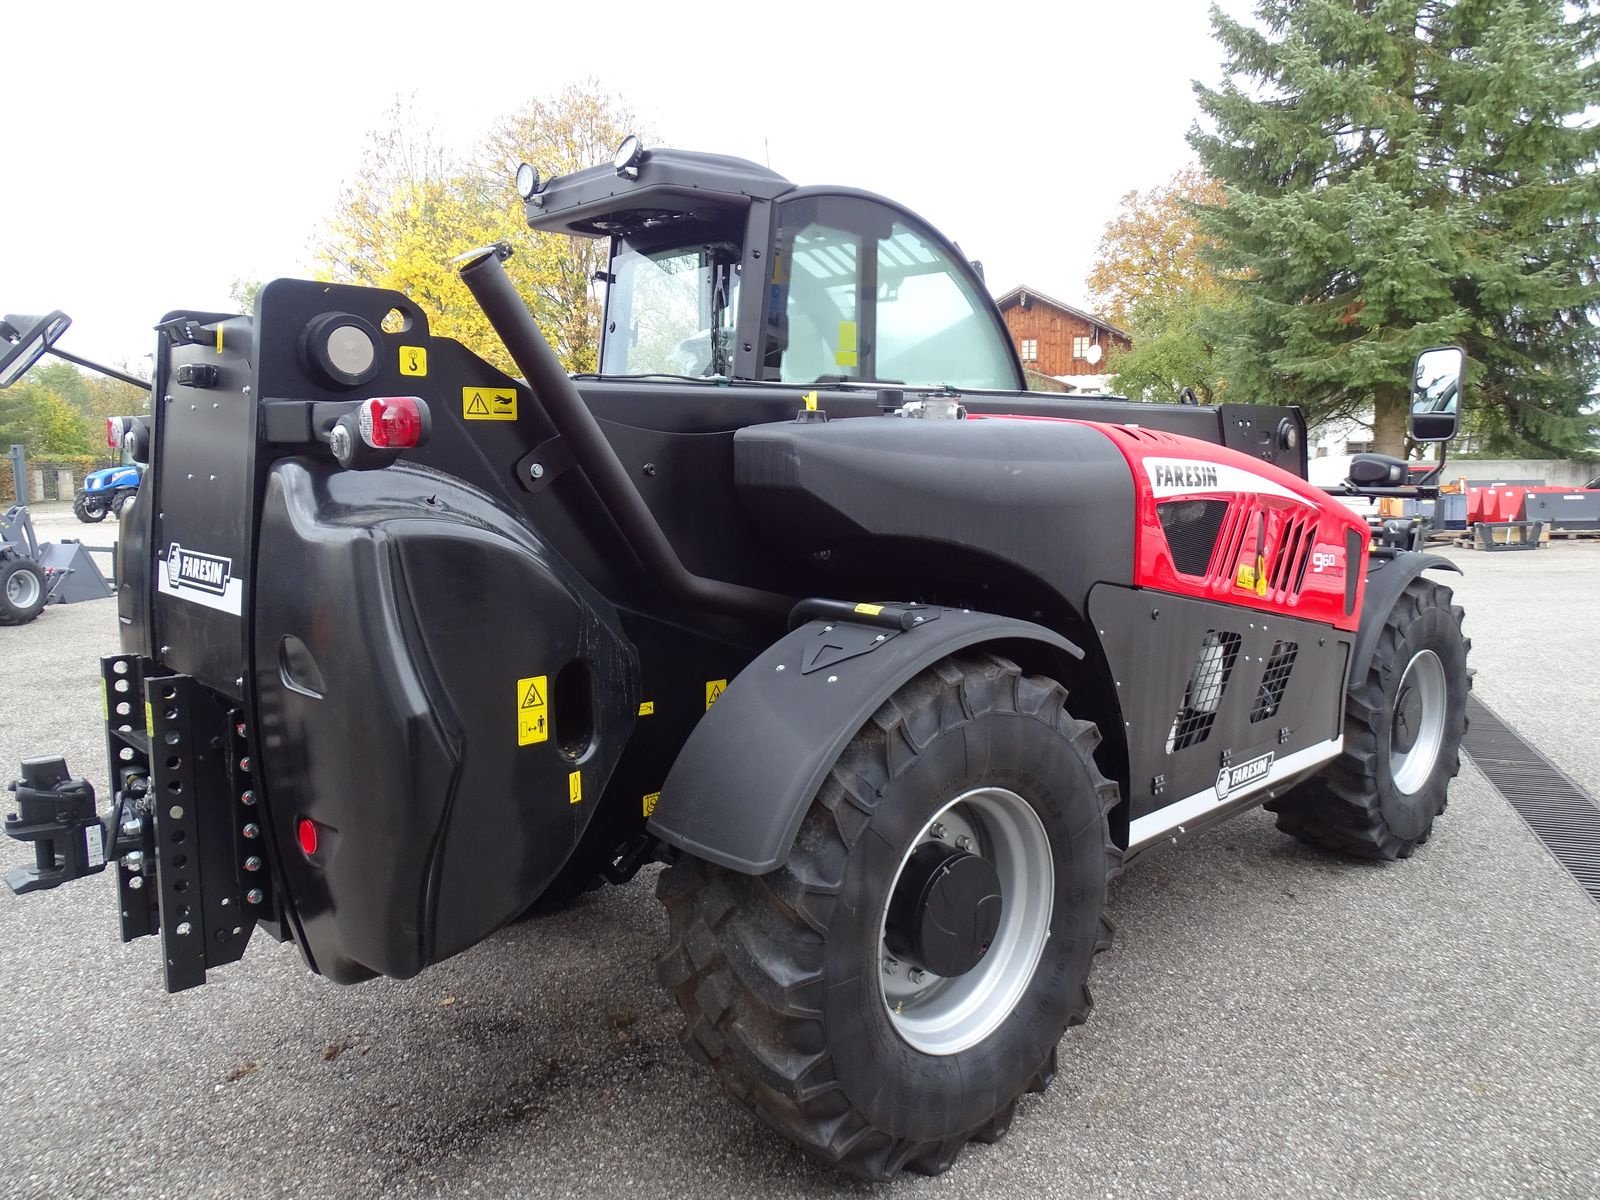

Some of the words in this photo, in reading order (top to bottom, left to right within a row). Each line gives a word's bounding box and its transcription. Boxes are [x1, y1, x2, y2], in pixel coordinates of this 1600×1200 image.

[1155, 465, 1217, 487] FARESIN
[181, 556, 224, 585] FARESIN
[1313, 552, 1335, 573] 960
[1231, 757, 1268, 786] FARESIN
